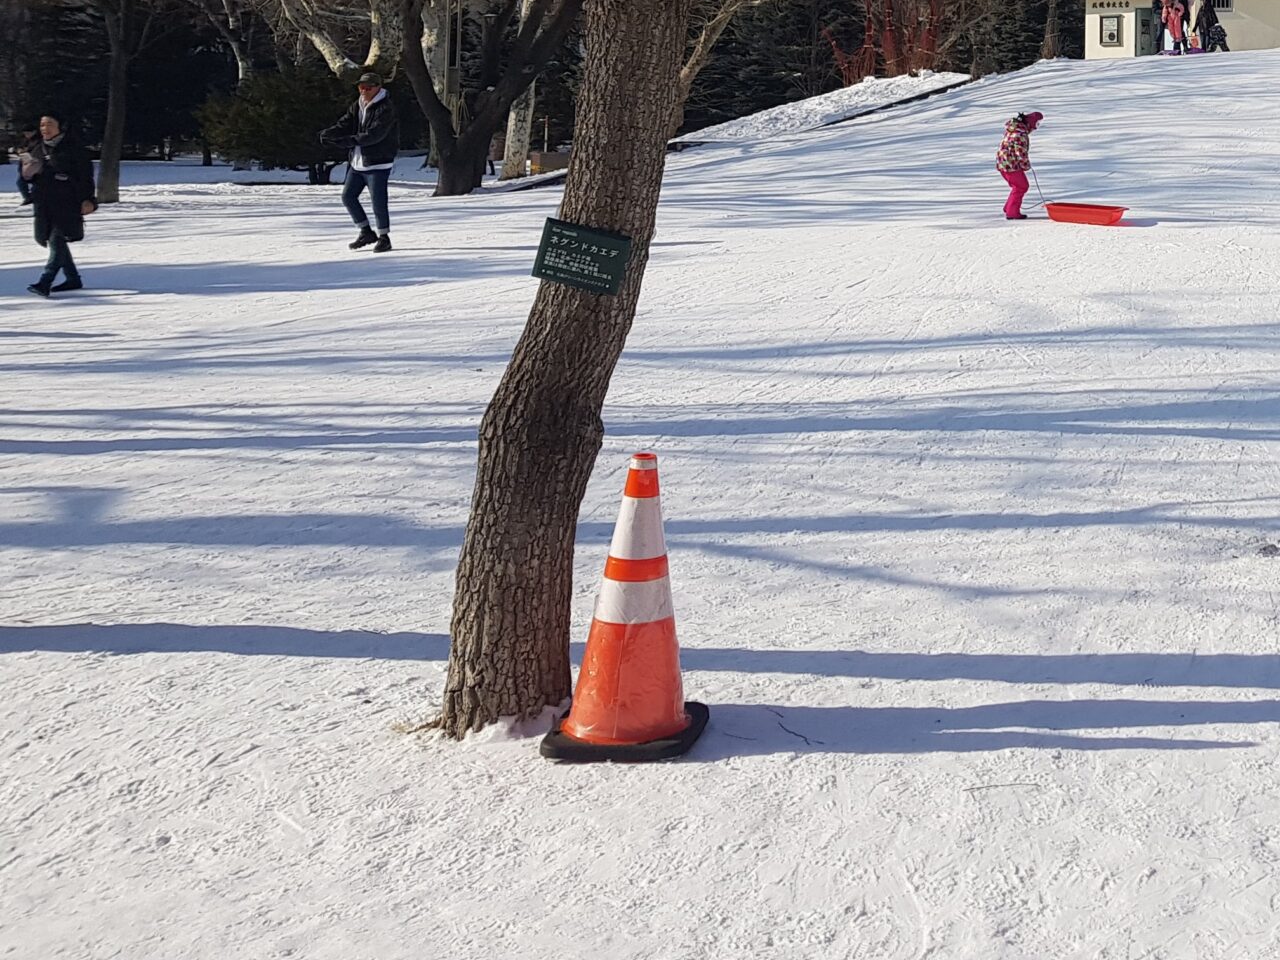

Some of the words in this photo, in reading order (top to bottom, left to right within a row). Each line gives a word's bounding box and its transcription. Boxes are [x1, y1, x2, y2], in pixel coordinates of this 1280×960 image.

[551, 236, 619, 257] ネグンドカエデ
